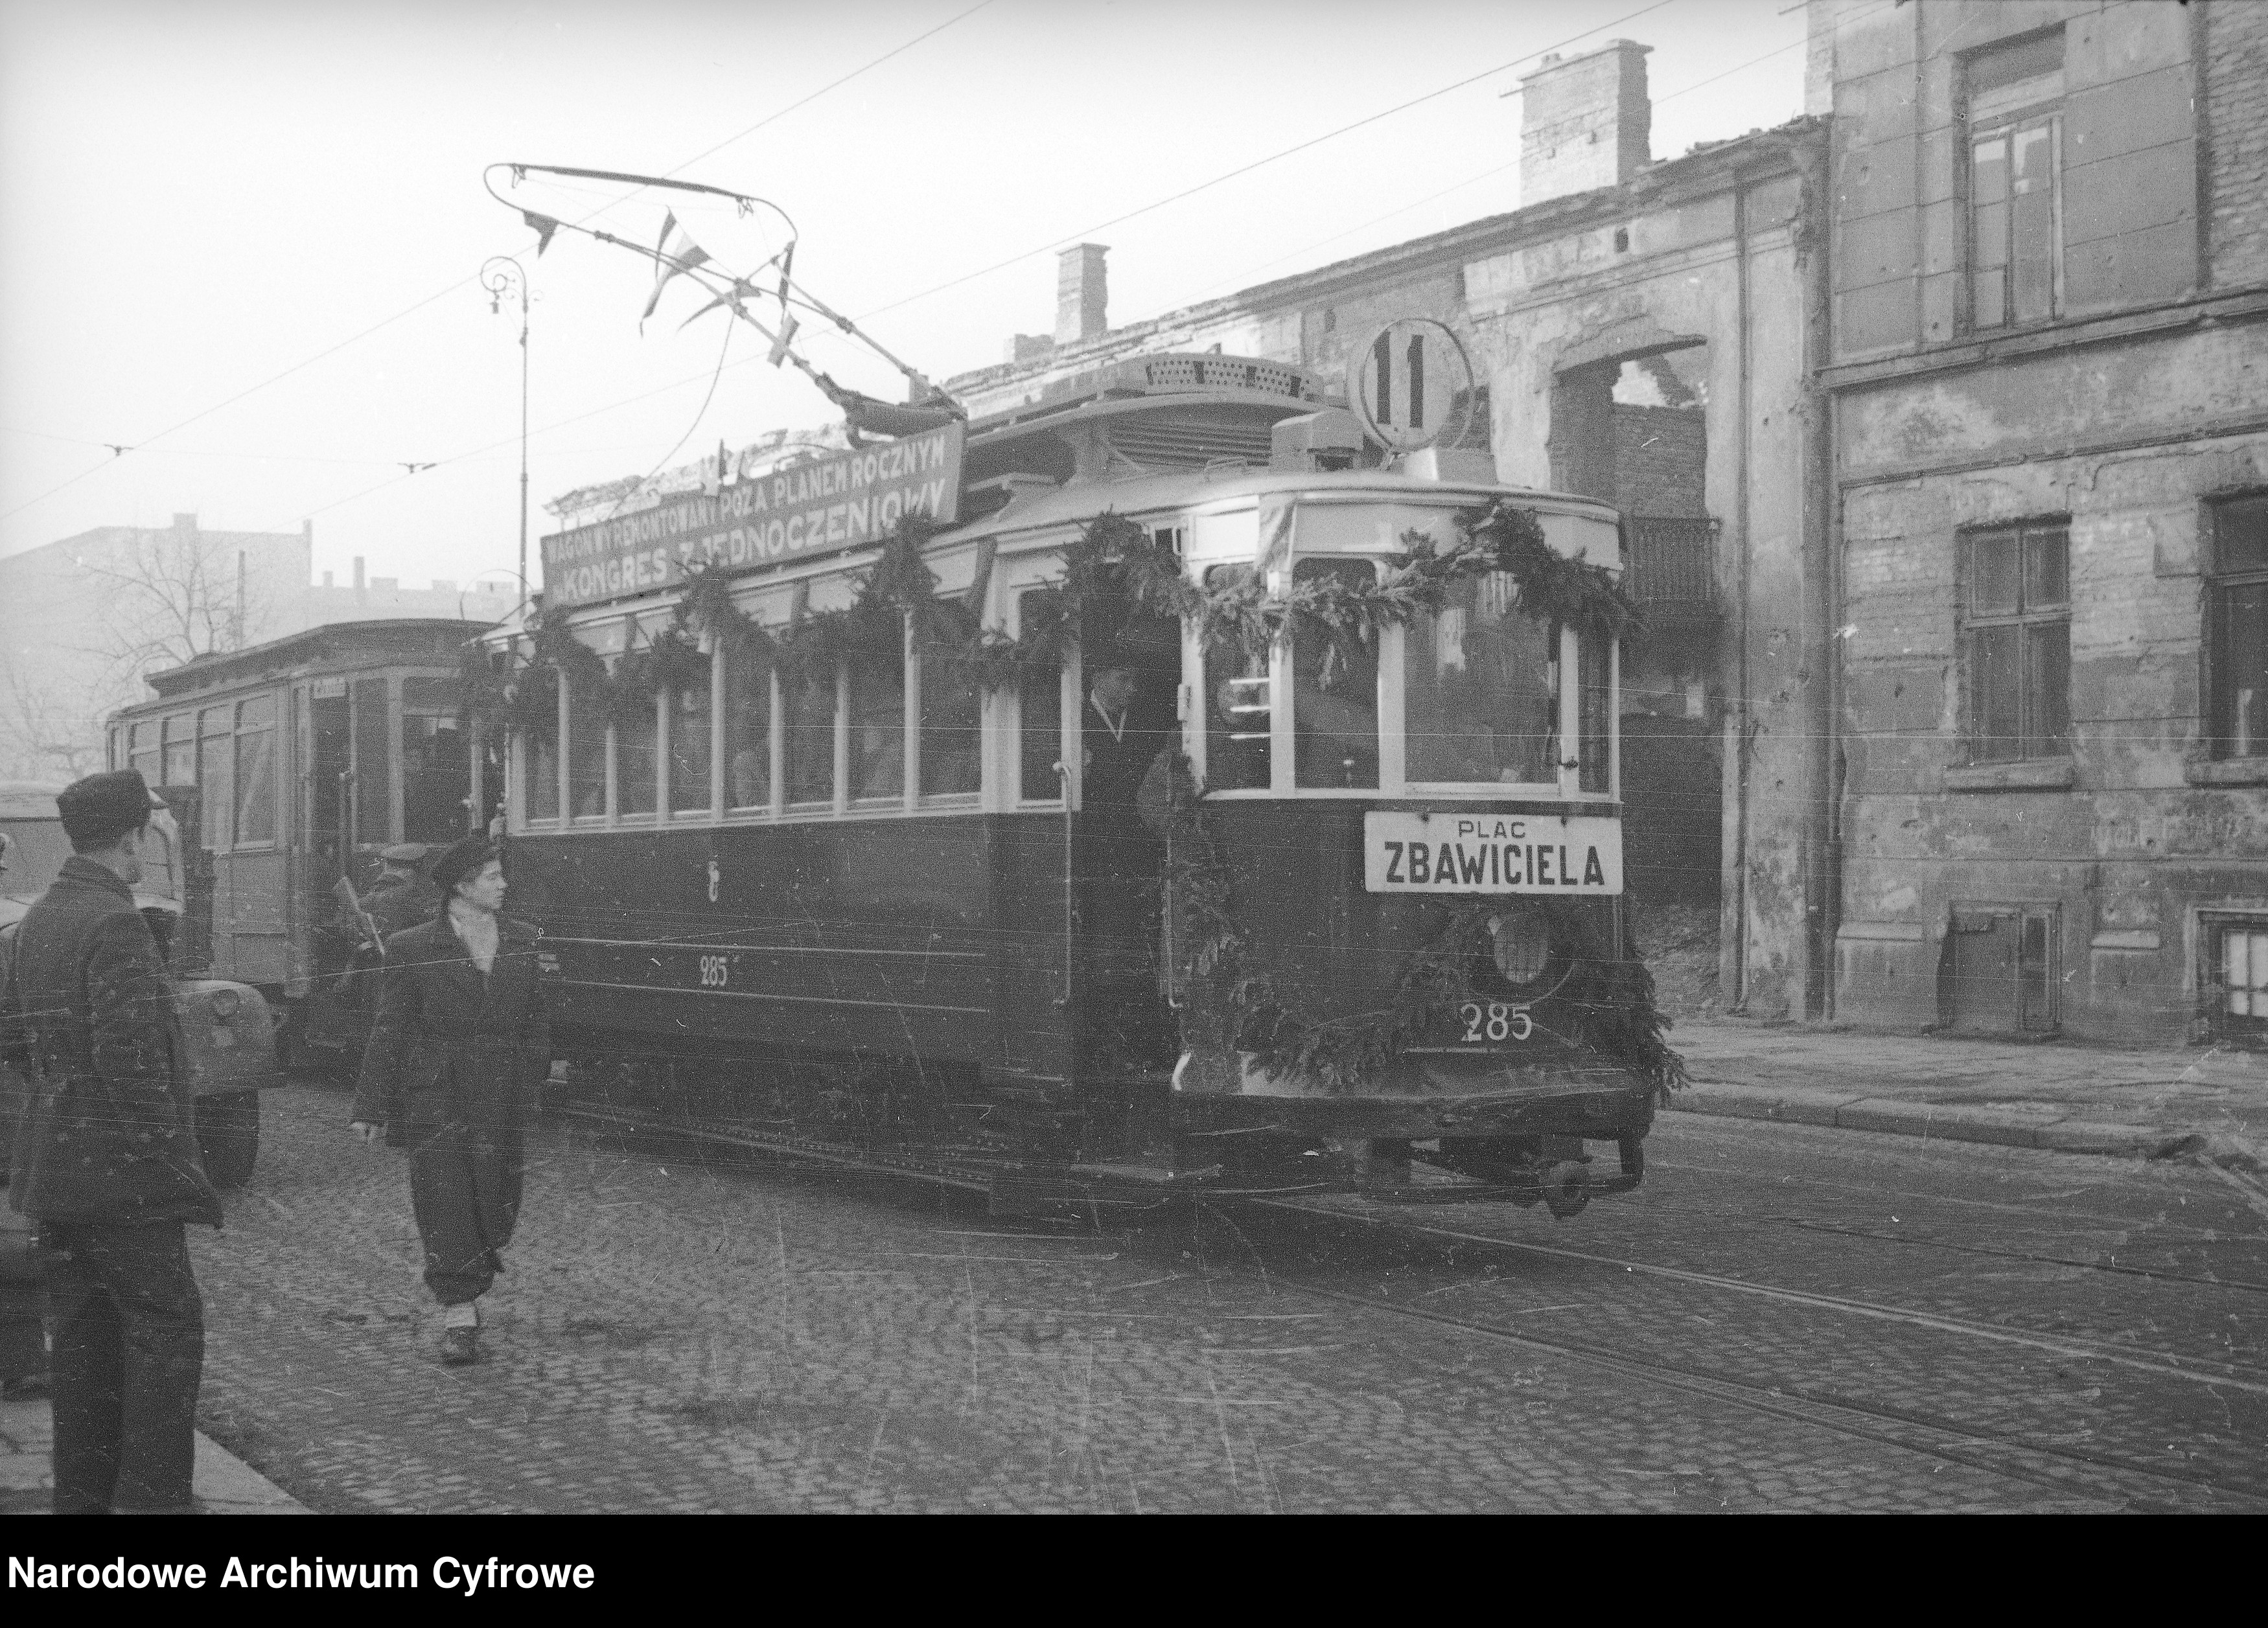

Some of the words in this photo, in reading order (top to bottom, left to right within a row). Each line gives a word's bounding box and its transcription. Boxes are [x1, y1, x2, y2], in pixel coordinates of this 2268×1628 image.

[1374, 332, 1424, 428] 11
[546, 529, 593, 565] WAGON
[594, 496, 717, 553] WYREMONTOWANY
[720, 487, 767, 523] POZA
[775, 464, 844, 507] PLANEM
[853, 437, 944, 486] ROCZNYM
[563, 548, 667, 600] KONGRES
[1459, 820, 1526, 839] PLAC
[1384, 842, 1606, 886] ZBAWICIELA
[700, 955, 727, 987] 285
[1461, 1004, 1533, 1042] 285
